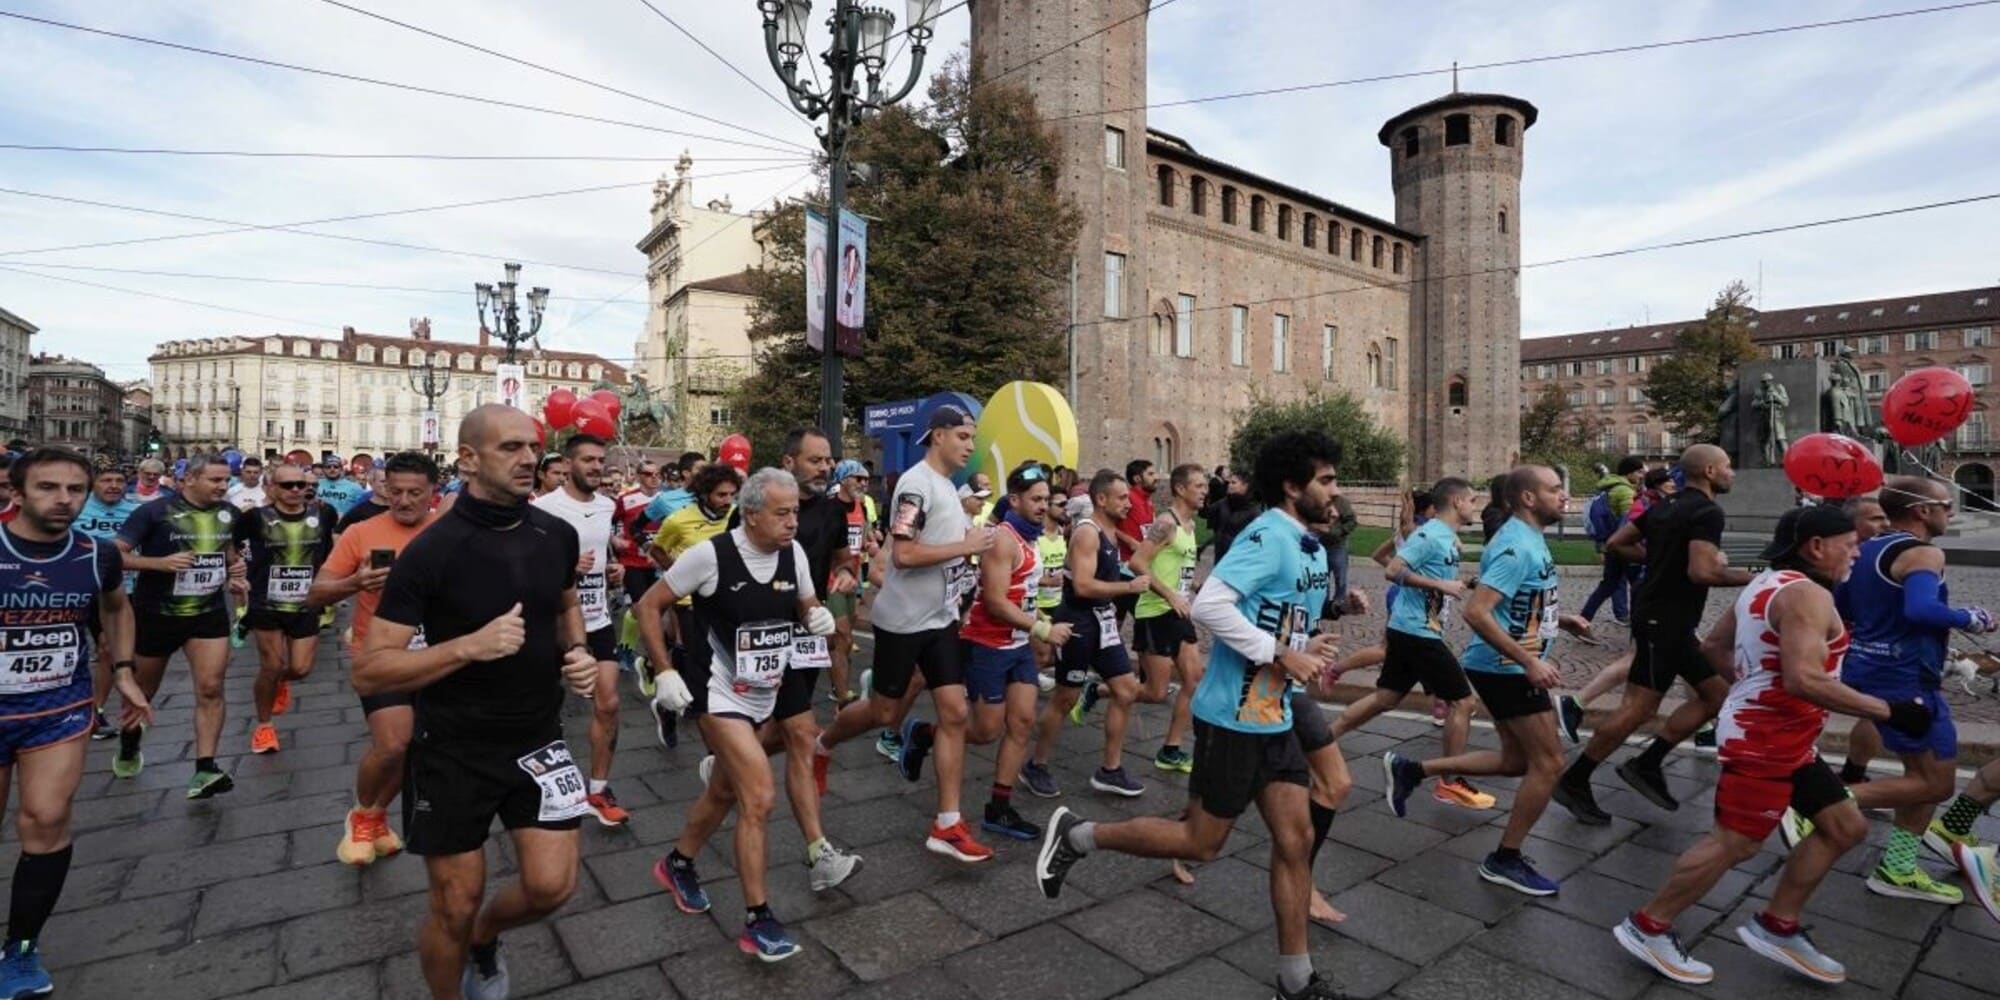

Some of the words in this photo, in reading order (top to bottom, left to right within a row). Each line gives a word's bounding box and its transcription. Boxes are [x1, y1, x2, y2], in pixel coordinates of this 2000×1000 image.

[319, 489, 348, 500] Jeep
[193, 556, 224, 567] Jeep
[193, 573, 214, 583] 167
[282, 568, 310, 578] Jeep
[281, 582, 301, 592] 682
[12, 630, 73, 647] Jeep
[753, 631, 789, 647] Jeep
[9, 655, 53, 674] 452
[754, 655, 779, 673] 735
[555, 772, 582, 796] 663
